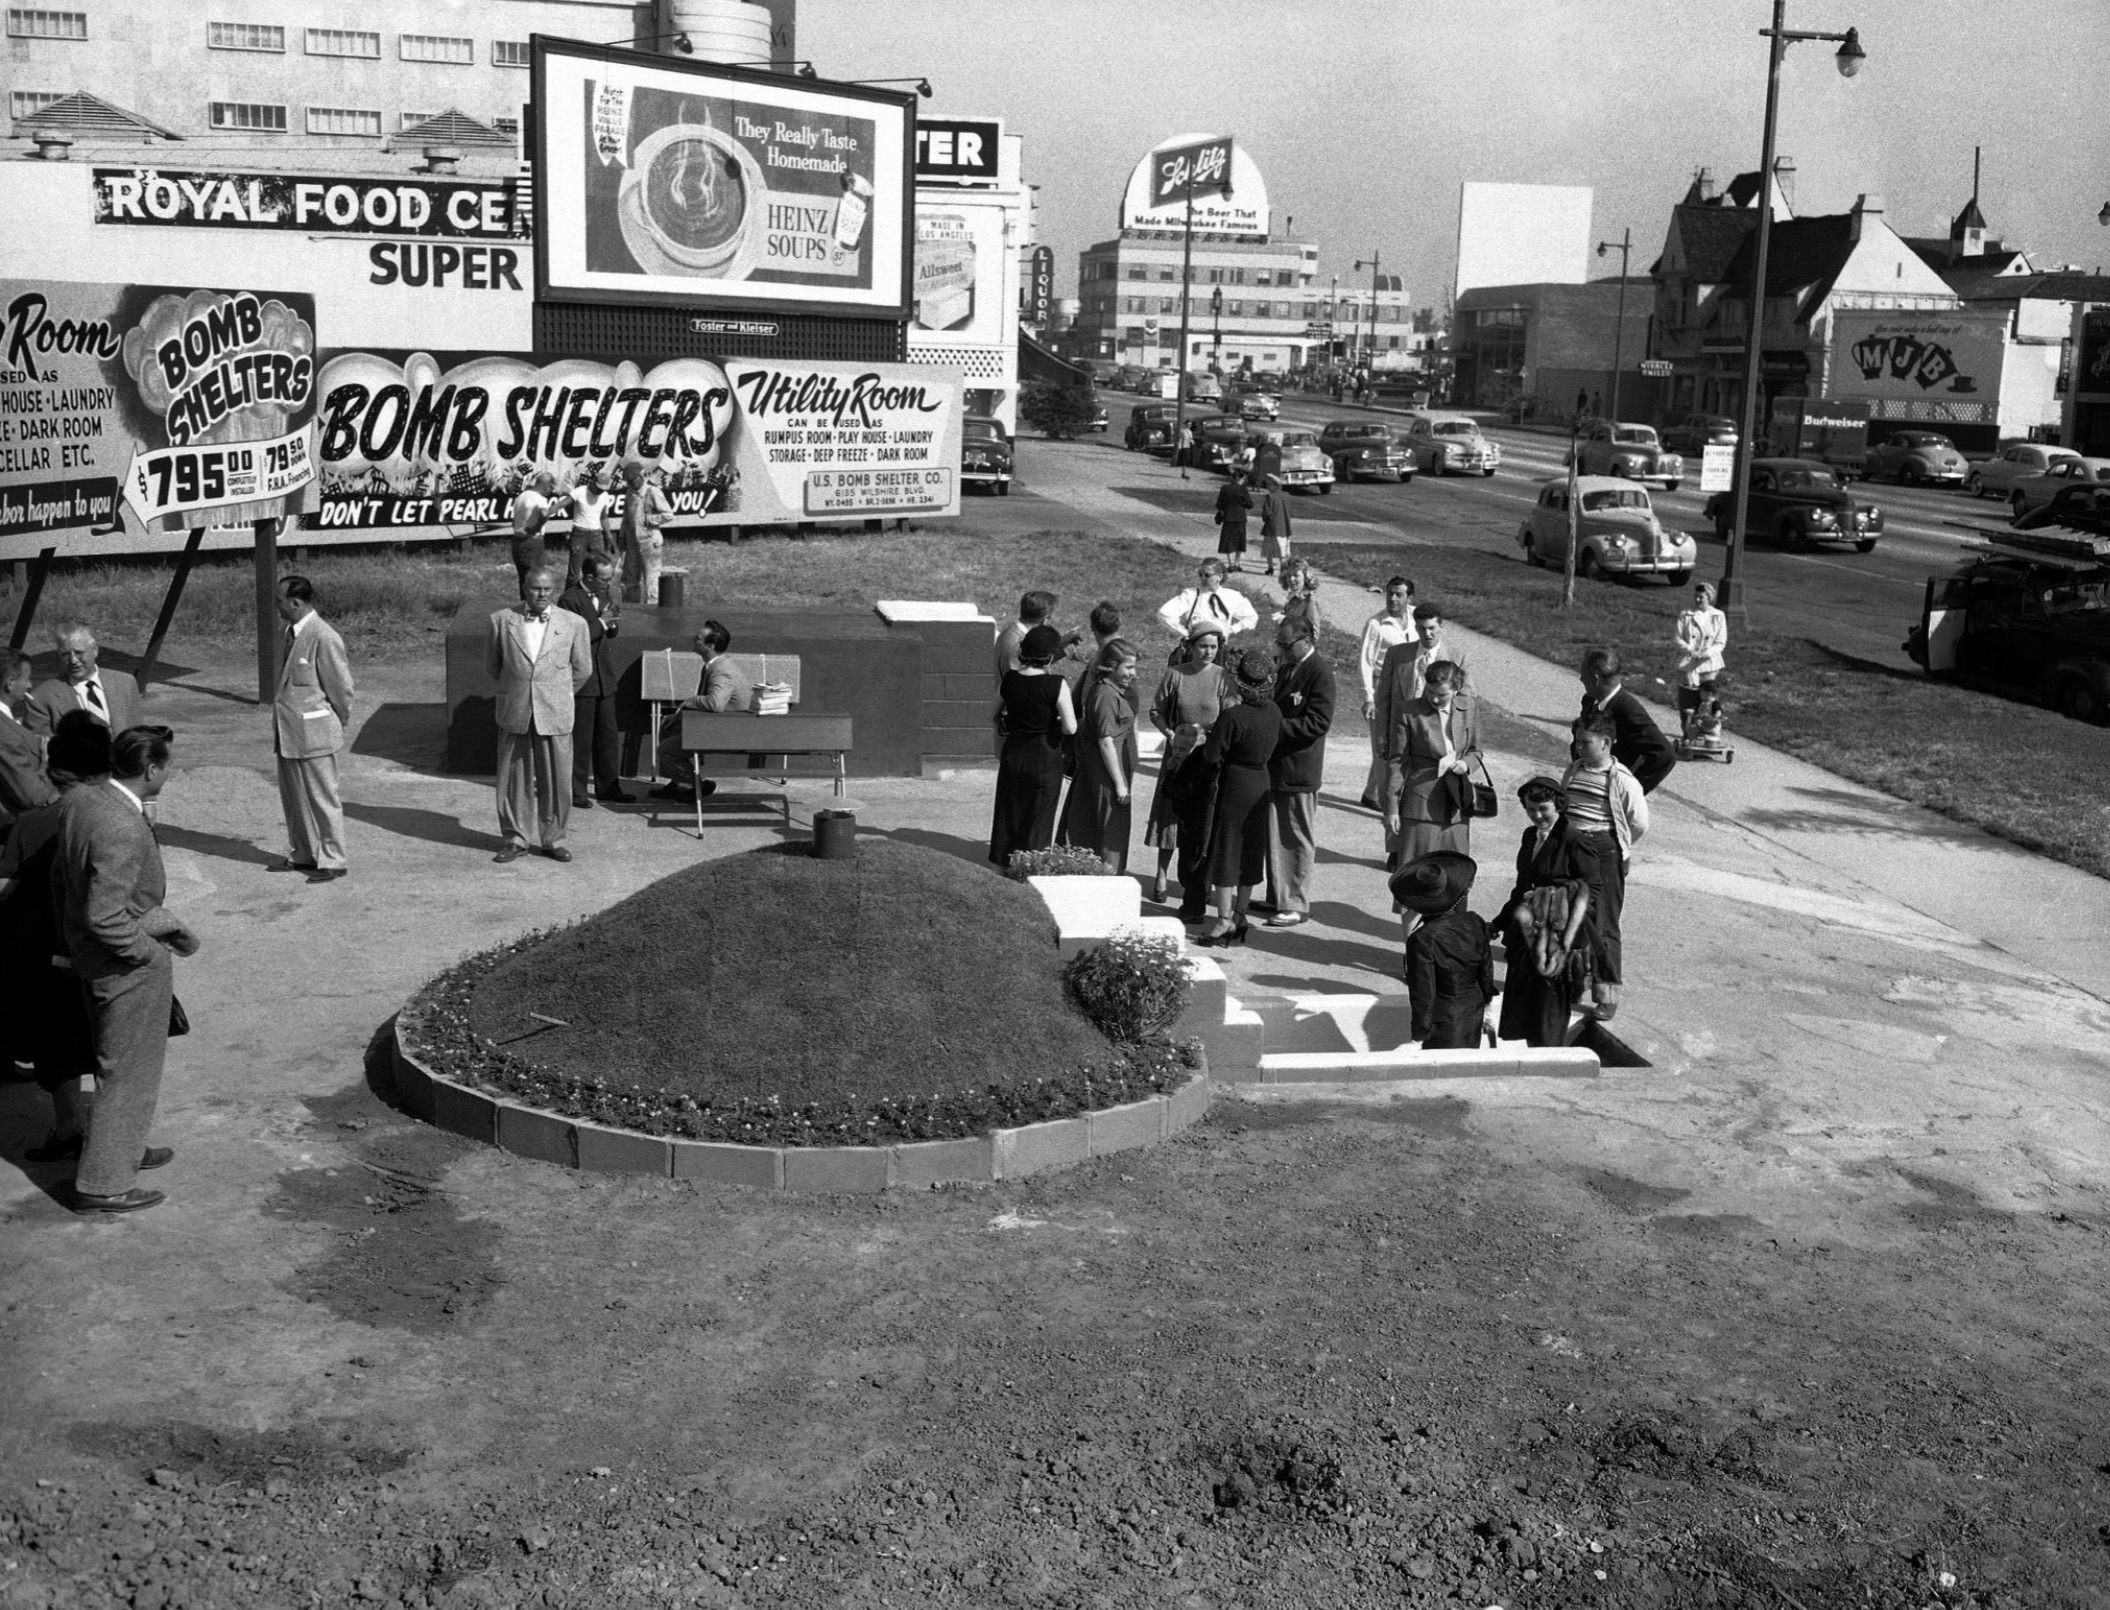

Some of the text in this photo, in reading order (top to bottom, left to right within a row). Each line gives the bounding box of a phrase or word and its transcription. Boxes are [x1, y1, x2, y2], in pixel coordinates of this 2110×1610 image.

[735, 116, 857, 151] They Really Taste
[767, 145, 847, 173] Homemade
[107, 174, 507, 232] ROYAL FOOD CE
[1207, 208, 1230, 218] Beer
[1235, 209, 1257, 219] That
[767, 204, 828, 234] HEINZ
[931, 221, 965, 230] MADE IN
[1135, 215, 1161, 225] Made
[1220, 219, 1258, 230] Famous
[767, 233, 826, 260] SOUPS
[920, 230, 974, 239] LOS ANGELES
[369, 242, 524, 291] SUPER
[919, 261, 963, 280] Allsweet
[1037, 250, 1049, 321] LIQUOR
[8, 292, 121, 382] Room
[695, 320, 726, 331] Foster
[739, 322, 775, 334] Kleiser
[158, 296, 262, 392] BOMB
[1862, 343, 1946, 381] MJB
[42, 370, 58, 382] AS
[2, 388, 114, 414] HOUSE LAUNDRY
[167, 350, 311, 446] SHELTERS
[738, 370, 942, 429] Utility Room
[20, 418, 60, 440] DARK
[63, 416, 103, 439] ROOM
[320, 383, 728, 462] BOMB SHELTERS
[787, 419, 883, 428] CAN BE USED AS
[1804, 415, 1866, 428] Budweiser
[764, 431, 933, 444] RUMPUS ROOM PLAY HOUSE LAUNDRY
[62, 444, 95, 468] ETC.
[291, 452, 306, 466] DOWN
[769, 448, 928, 462] STORAGE DEEP FREEZE DARK ROOM
[227, 476, 257, 486] COMPLETELY
[288, 467, 311, 485] Financing
[813, 472, 943, 487] U.S. BOMB SHELTER CO.
[231, 486, 255, 496] INSTALLED
[860, 487, 900, 496] WILSHIRE
[28, 489, 71, 526] happen
[75, 489, 87, 516] to
[90, 496, 111, 521] you
[320, 498, 383, 525] DON'T
[391, 500, 434, 523] LET
[439, 498, 498, 521] PEARL
[672, 488, 718, 519] YOU!
